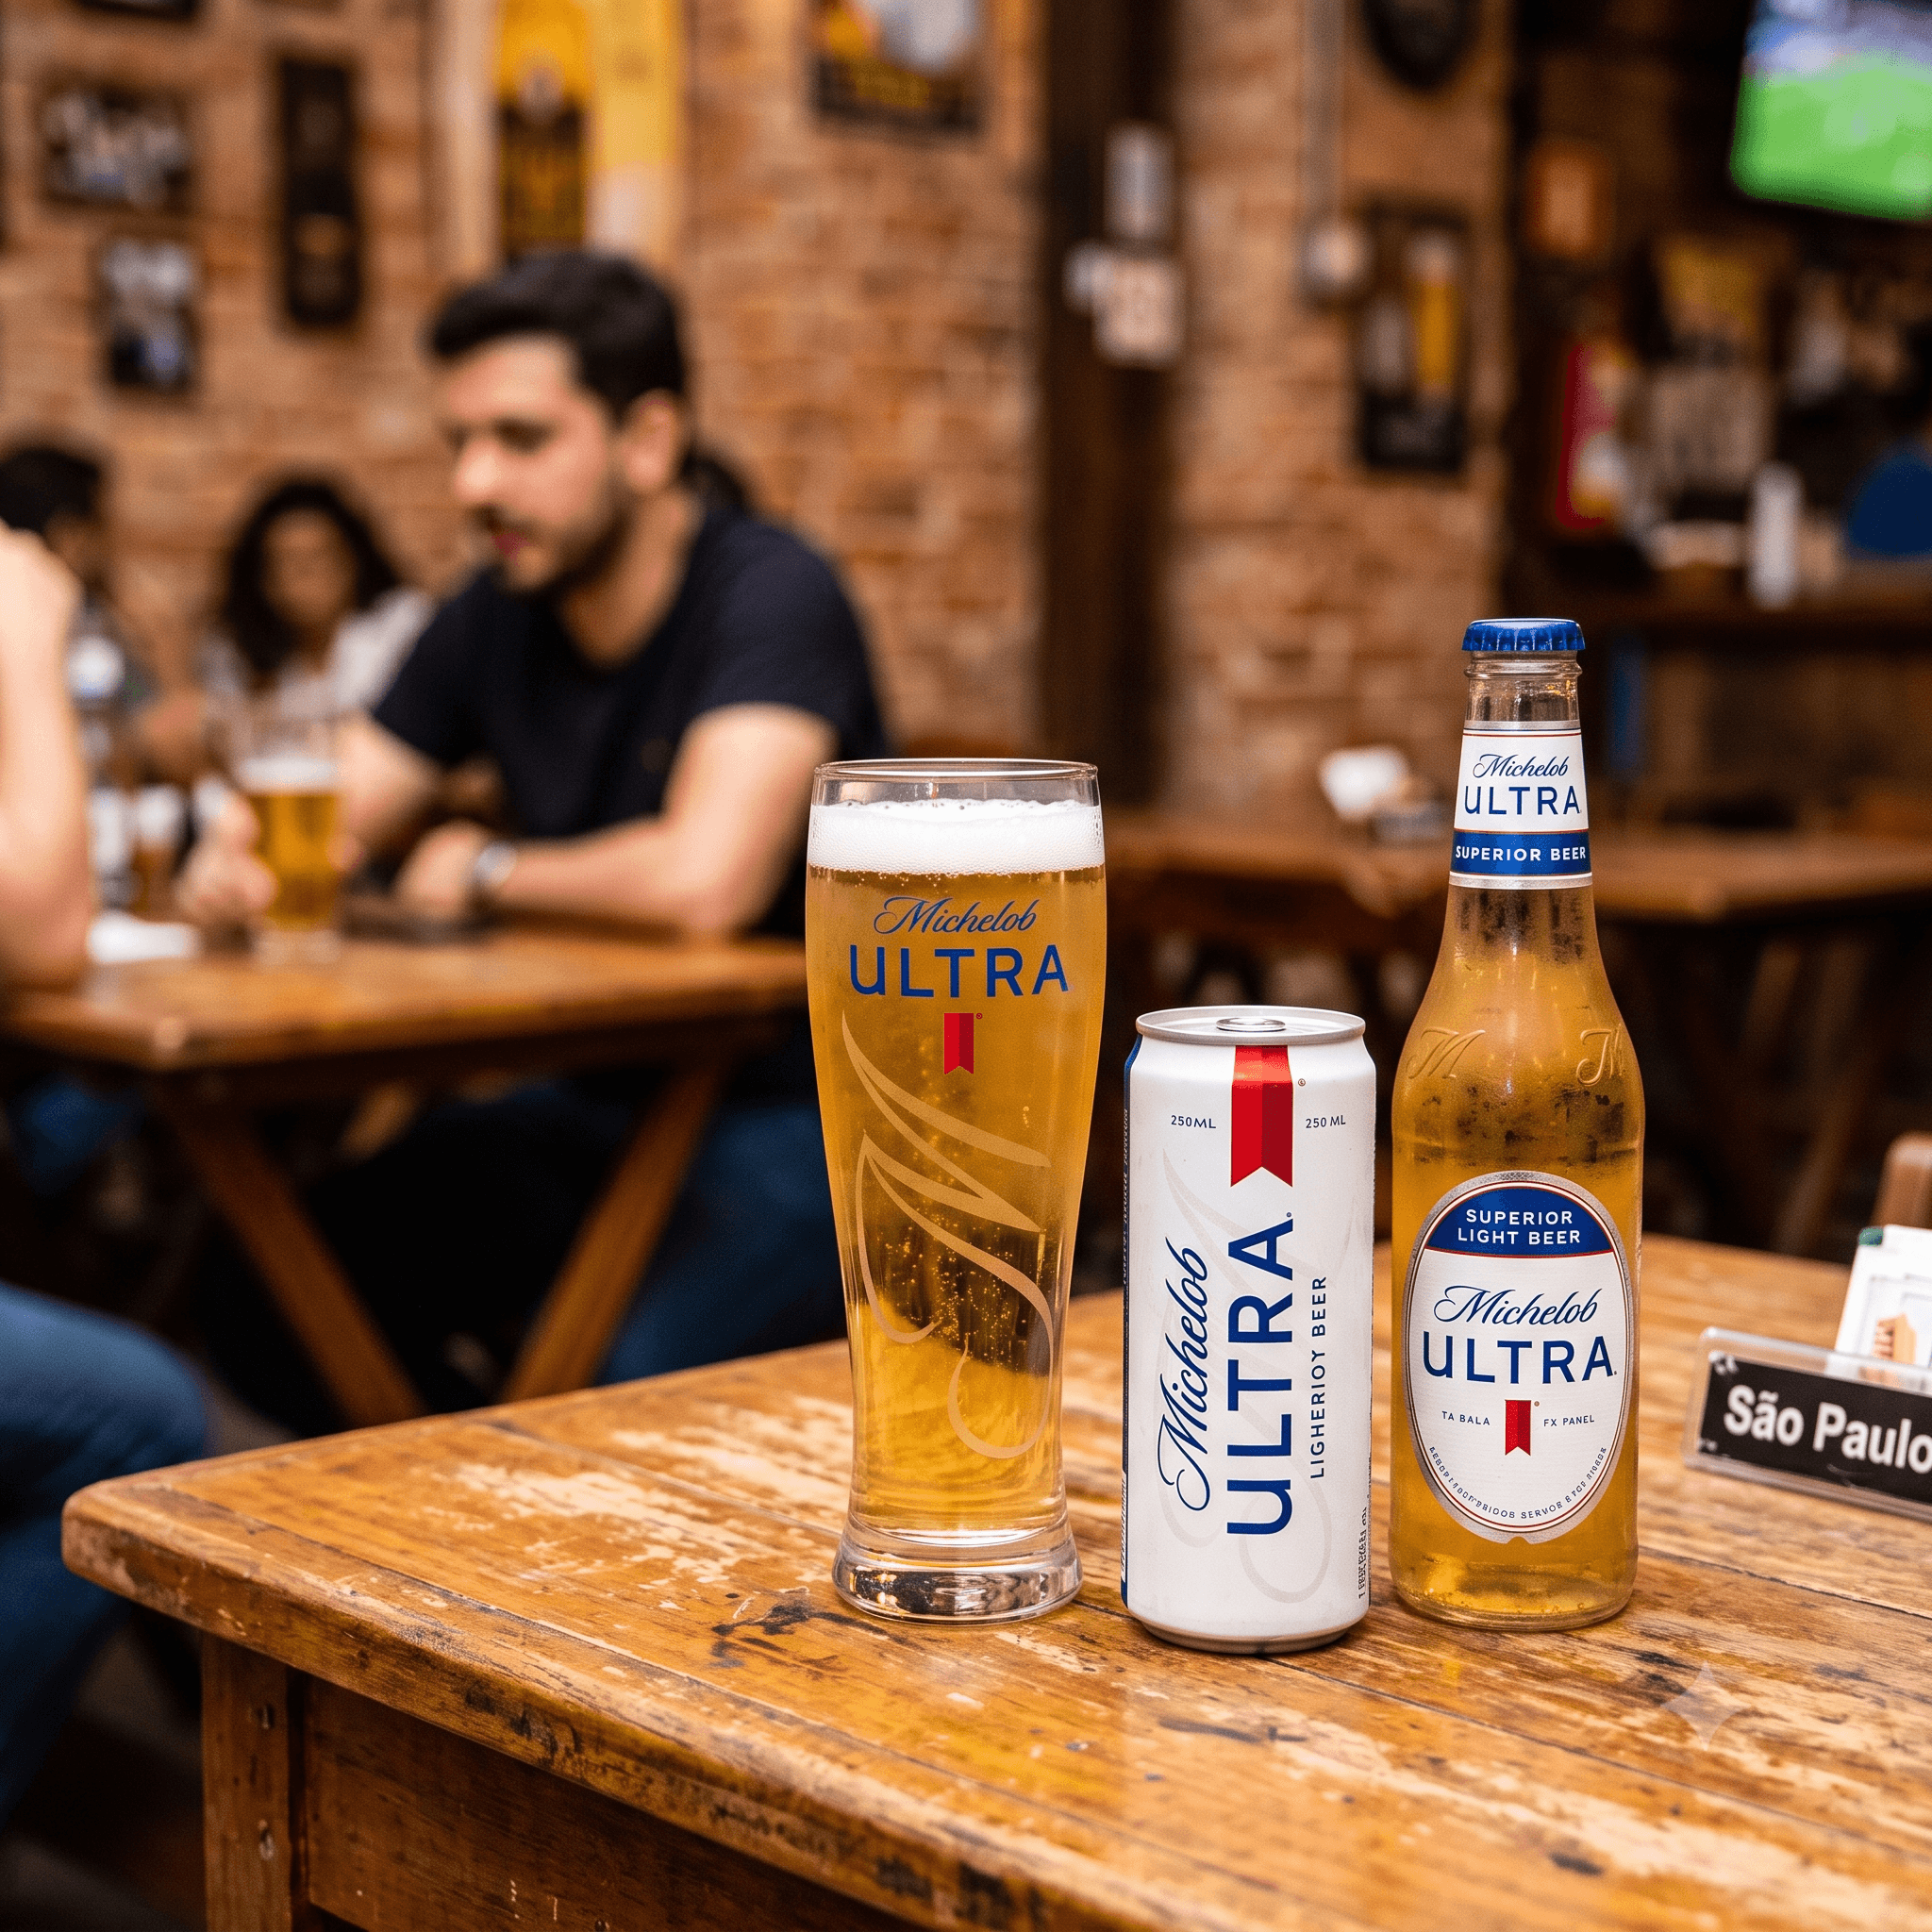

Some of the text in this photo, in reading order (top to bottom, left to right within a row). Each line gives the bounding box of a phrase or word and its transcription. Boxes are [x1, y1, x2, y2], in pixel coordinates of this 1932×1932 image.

[1473, 753, 1570, 779] Michelob
[1464, 785, 1581, 816] ULTRA
[1455, 845, 1587, 862] SUPERIOR BEER
[873, 895, 1041, 935] Michelob
[849, 944, 1070, 998] ULTRA
[1305, 1117, 1327, 1129] 250
[1466, 1208, 1574, 1225] SUPERIOR
[1457, 1227, 1581, 1245] LIGHT BEER
[1433, 1285, 1603, 1325] Michelob
[1157, 1236, 1210, 1511] Michelob
[1423, 1330, 1614, 1385] ULTRA
[1226, 1218, 1293, 1535] ULTRA
[1309, 1276, 1326, 1479] LIGHERIOY BEER
[1441, 1410, 1491, 1426] TA BALA
[1543, 1414, 1595, 1427] FX PANEL
[1724, 1384, 1932, 1474] São Paulo
